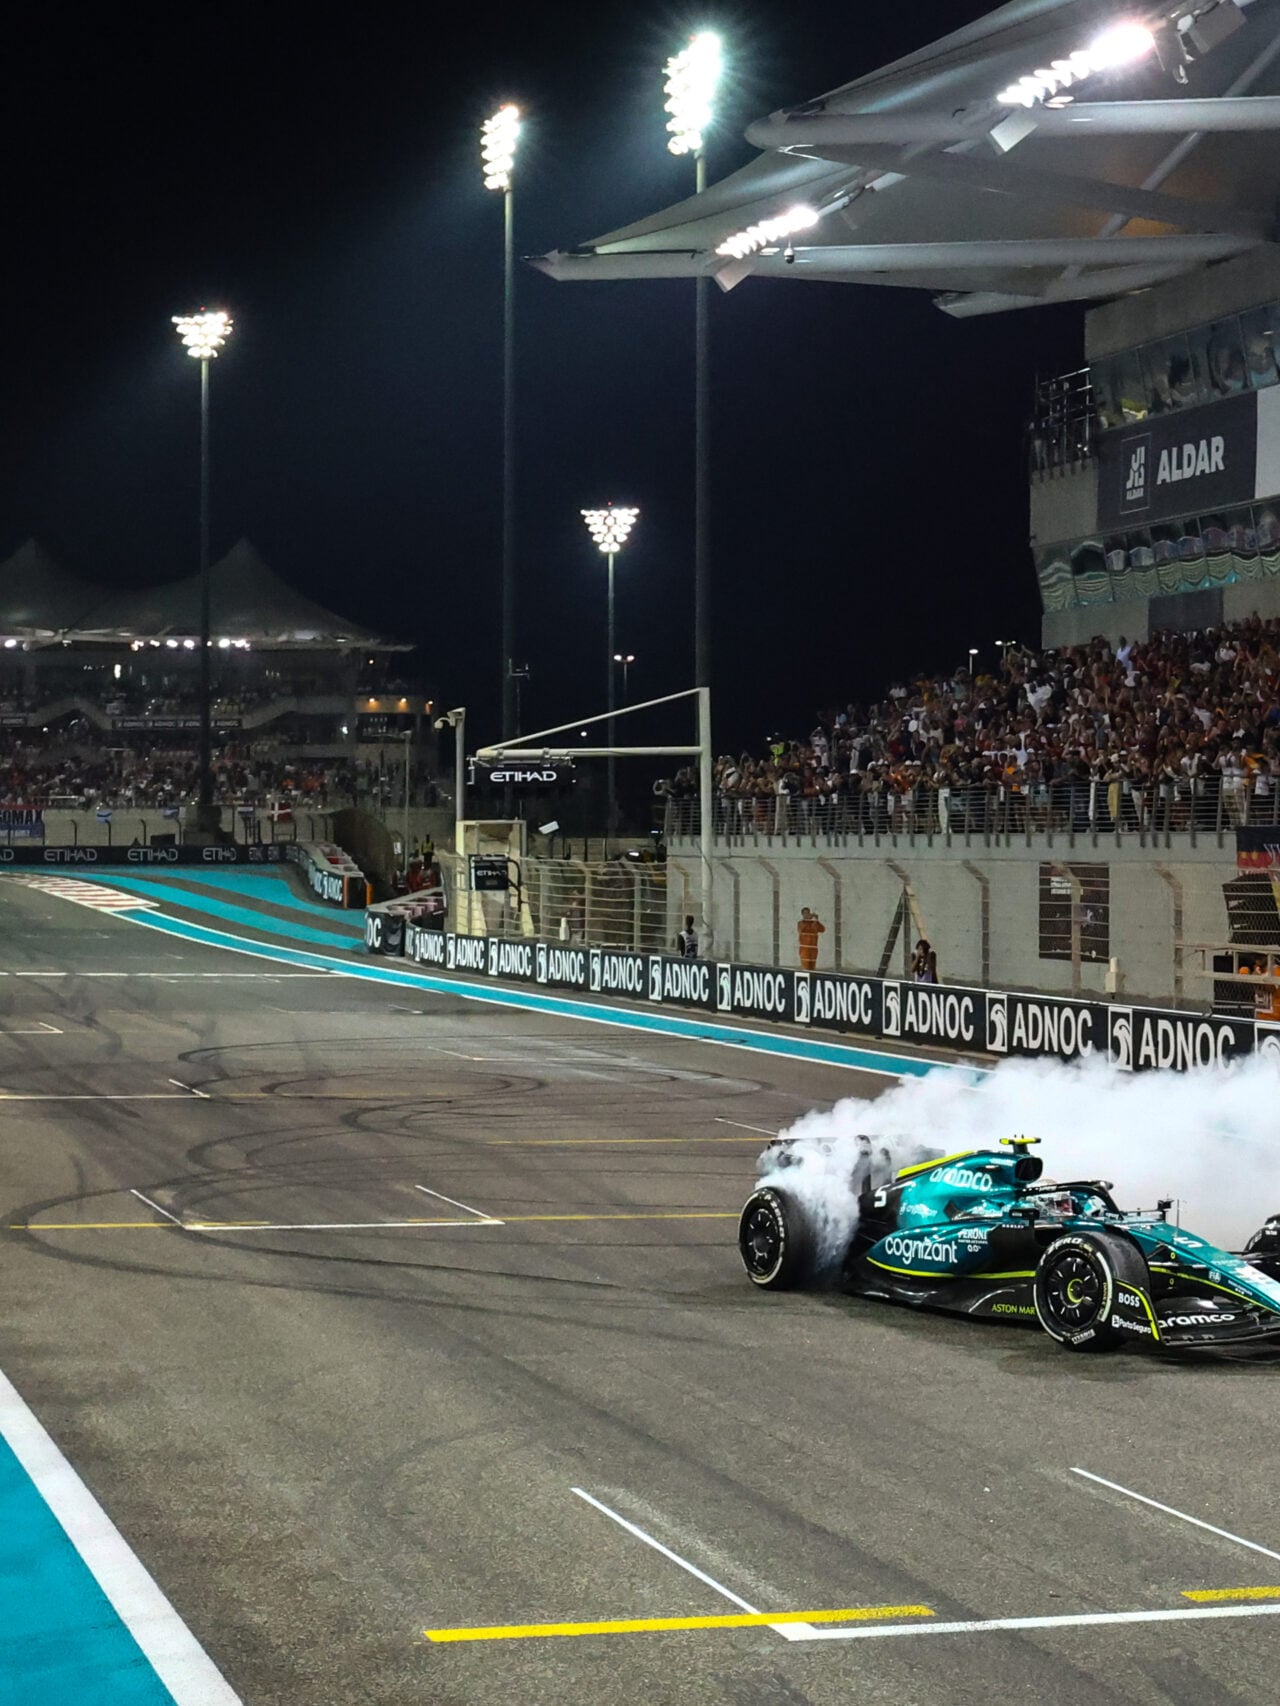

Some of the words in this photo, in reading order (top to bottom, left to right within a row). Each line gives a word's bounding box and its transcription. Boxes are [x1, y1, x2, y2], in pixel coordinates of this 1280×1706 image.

[1156, 436, 1225, 485] ALDAR
[490, 771, 557, 782] ETIHAD
[44, 848, 97, 861] ETIHAD
[127, 848, 178, 861] ETIHAD
[421, 933, 444, 963] ADNOC
[456, 938, 485, 971] ADNOC
[500, 943, 532, 975] ADNOC
[548, 948, 584, 983] ADNOC
[602, 955, 643, 992] ADNOC
[664, 962, 709, 1002] ADNOC
[734, 966, 786, 1013] ADNOC
[813, 980, 872, 1025] ADNOC
[904, 990, 974, 1042] ADNOC
[1013, 1003, 1093, 1056] ADNOC
[1139, 1017, 1236, 1073] ADNOC
[929, 1168, 993, 1192] aramco
[874, 1189, 888, 1208] 5
[885, 1237, 958, 1265] cognizant
[992, 1304, 1018, 1314] ASTON
[1118, 1292, 1141, 1308] BOSS
[1158, 1313, 1235, 1329] aramco
